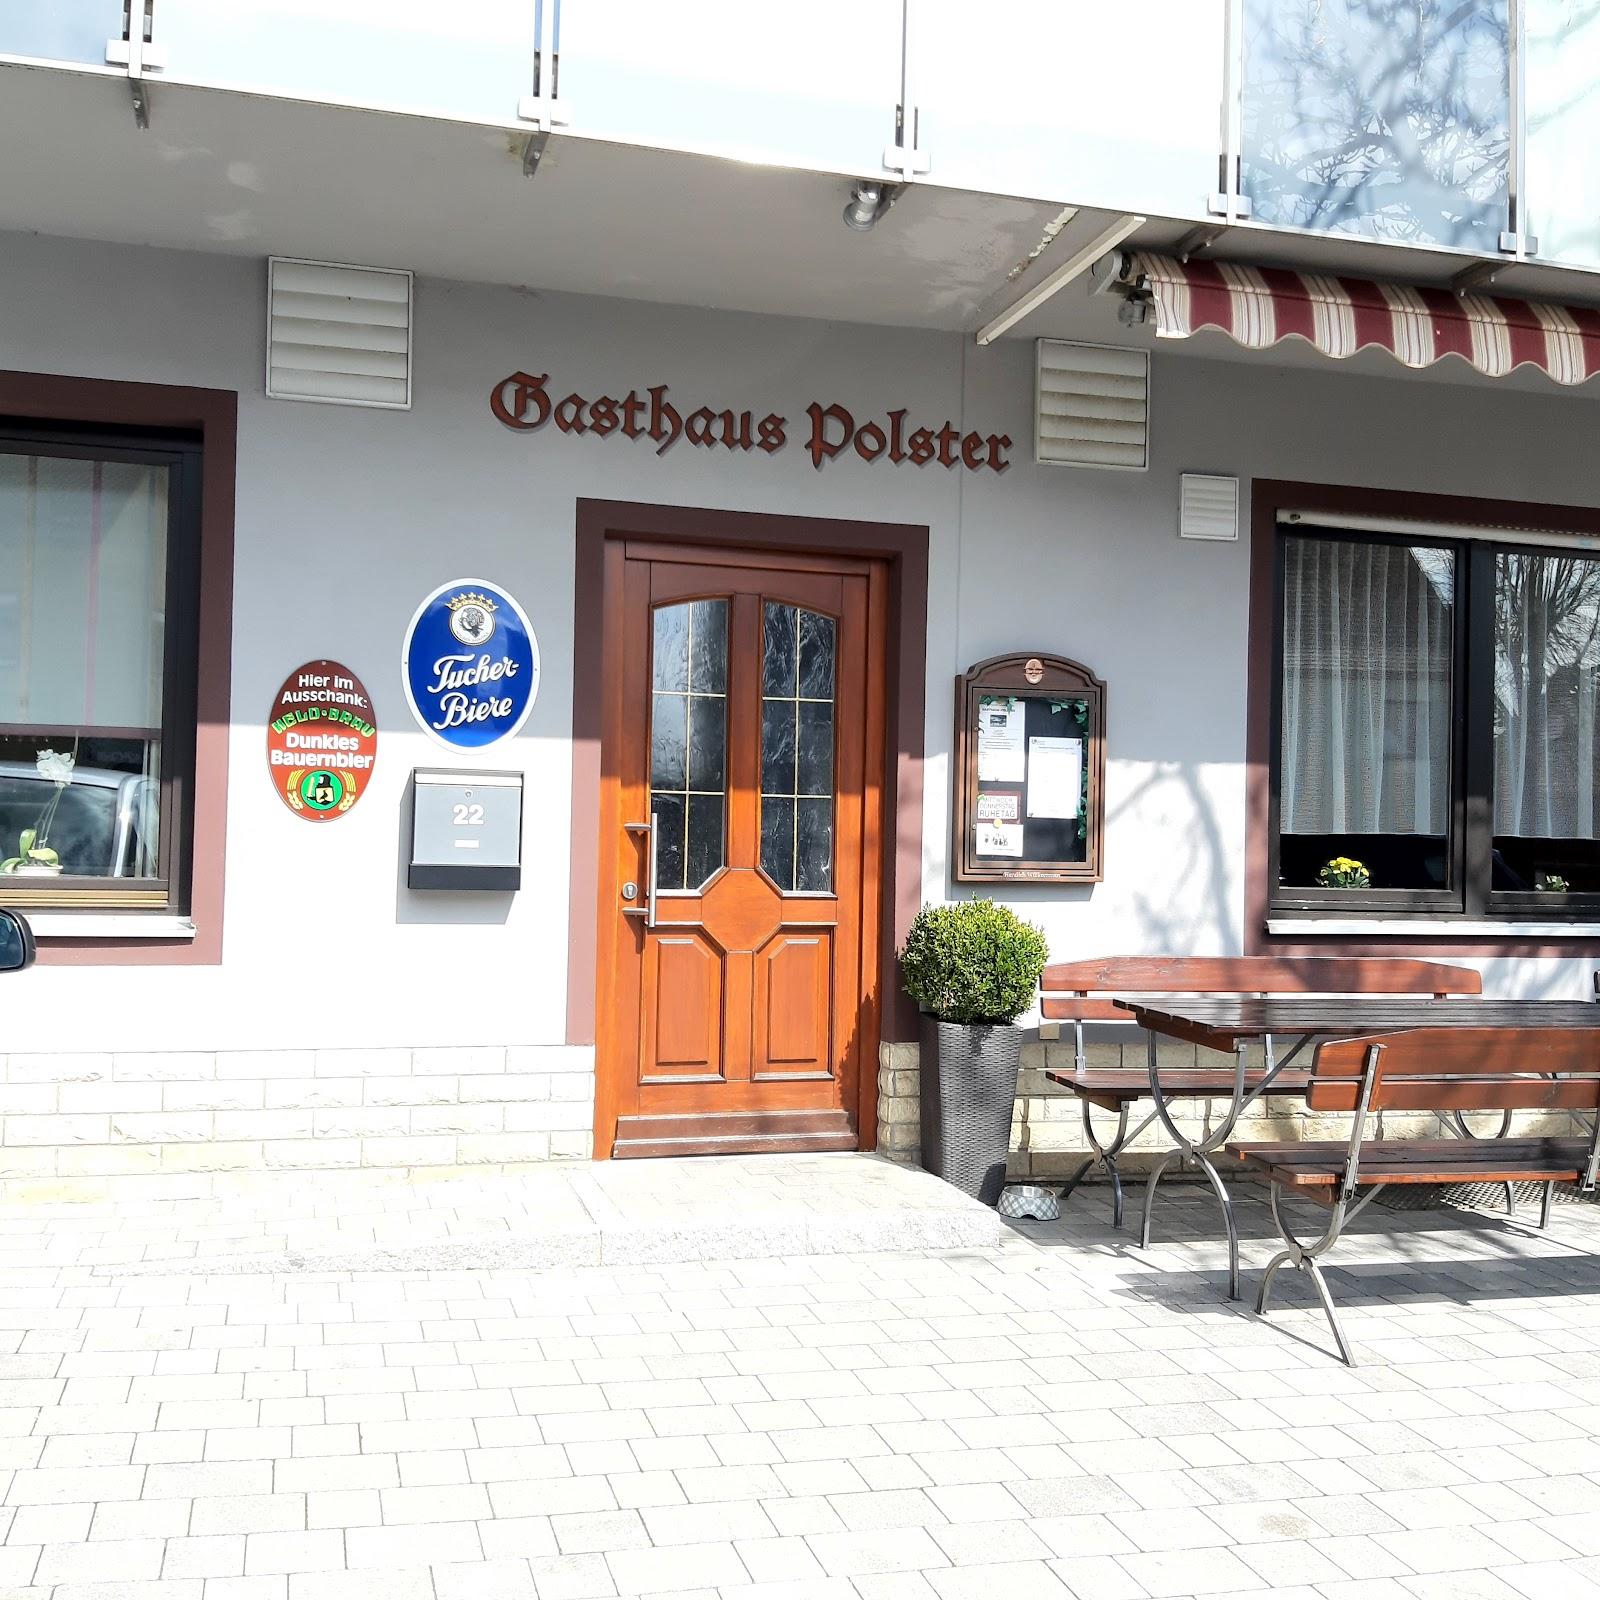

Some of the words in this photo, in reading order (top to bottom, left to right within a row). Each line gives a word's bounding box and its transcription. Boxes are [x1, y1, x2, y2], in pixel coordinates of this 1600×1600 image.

[489, 370, 787, 456] Gasthaus
[804, 401, 1014, 473] Polster
[298, 673, 331, 688] Hier
[333, 675, 354, 690] im
[426, 653, 520, 693] Tucher-
[281, 689, 368, 709] Ausschank:
[433, 691, 513, 730] Biere
[285, 732, 359, 751] Dunkles
[270, 749, 374, 768] Bauernbier
[453, 803, 485, 825] 22
[979, 809, 1016, 818] RUHETAG
